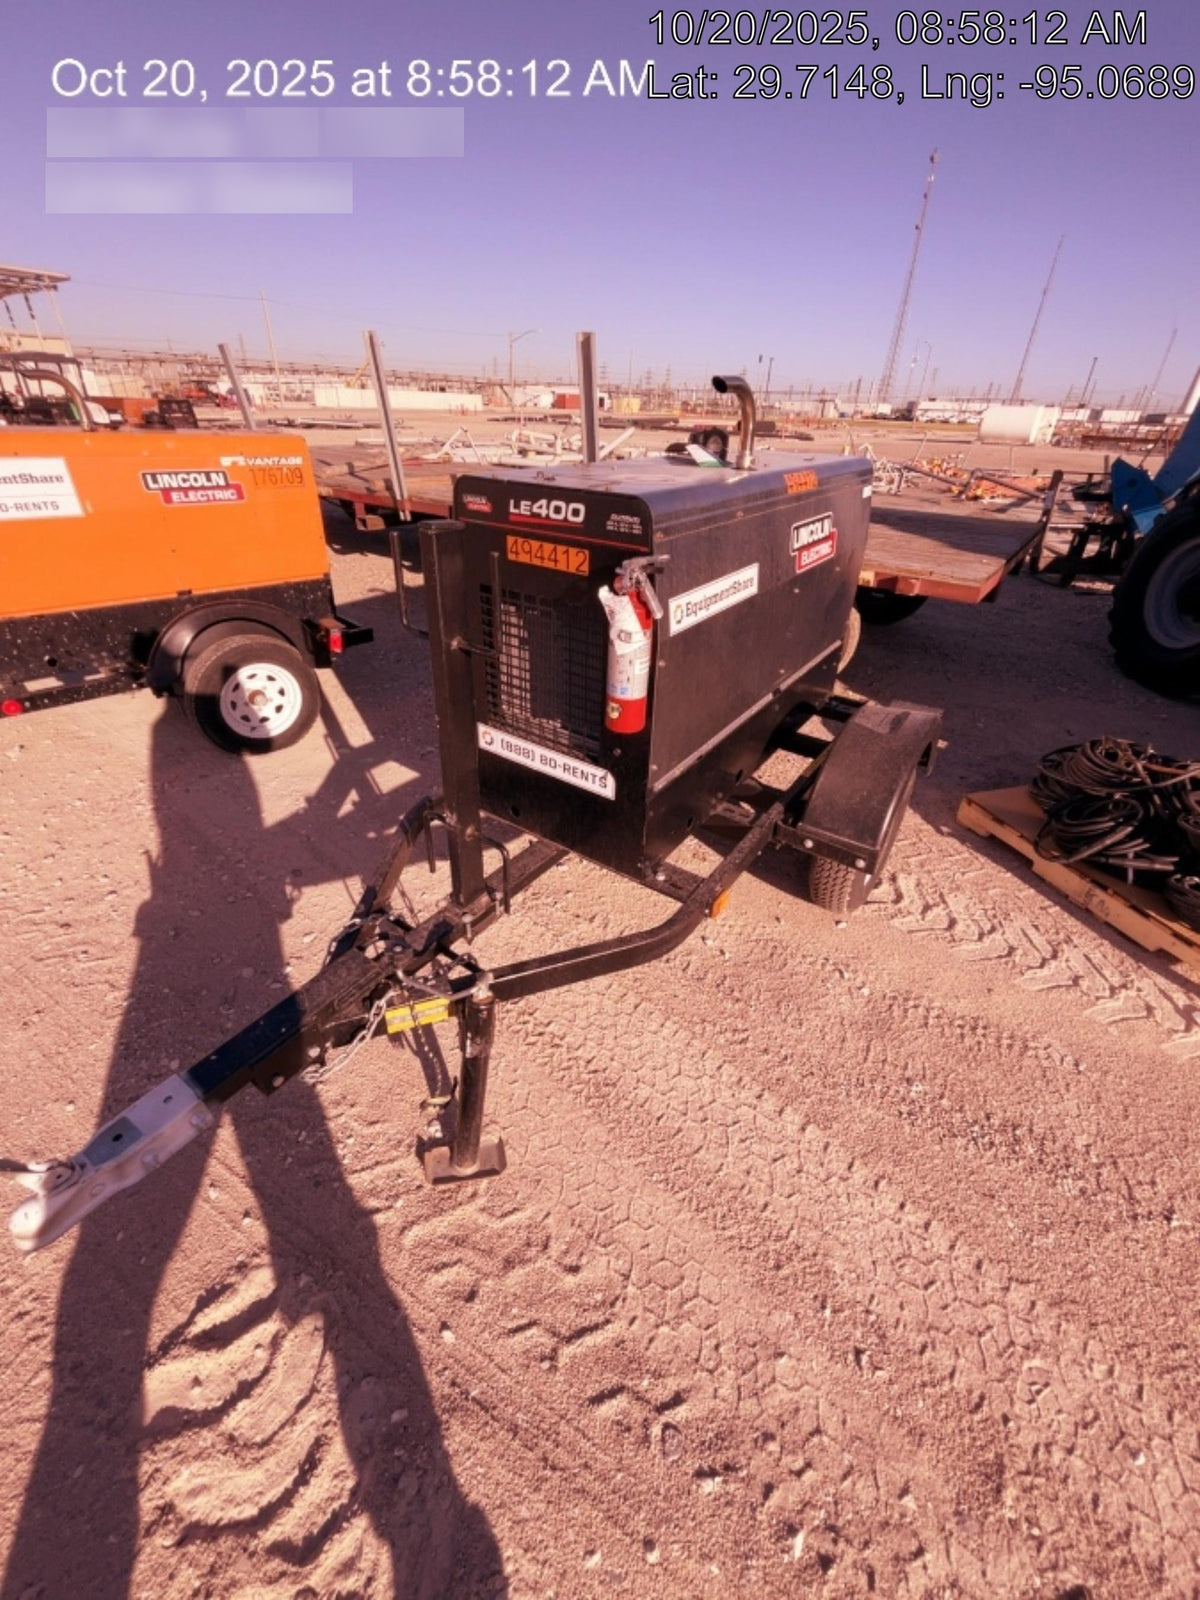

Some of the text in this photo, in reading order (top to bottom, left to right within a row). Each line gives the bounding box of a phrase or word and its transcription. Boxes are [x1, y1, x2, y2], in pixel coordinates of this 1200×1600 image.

[246, 456, 303, 466] VANTAGE
[146, 472, 226, 489] LINCOLN
[250, 467, 304, 487] 176709
[172, 489, 238, 502] ELECTRIC
[509, 498, 585, 523] LE400
[793, 518, 831, 550] LINCOLN
[508, 537, 589, 575] 494412
[685, 577, 755, 617] EquipmentShare
[500, 735, 536, 763] (888)
